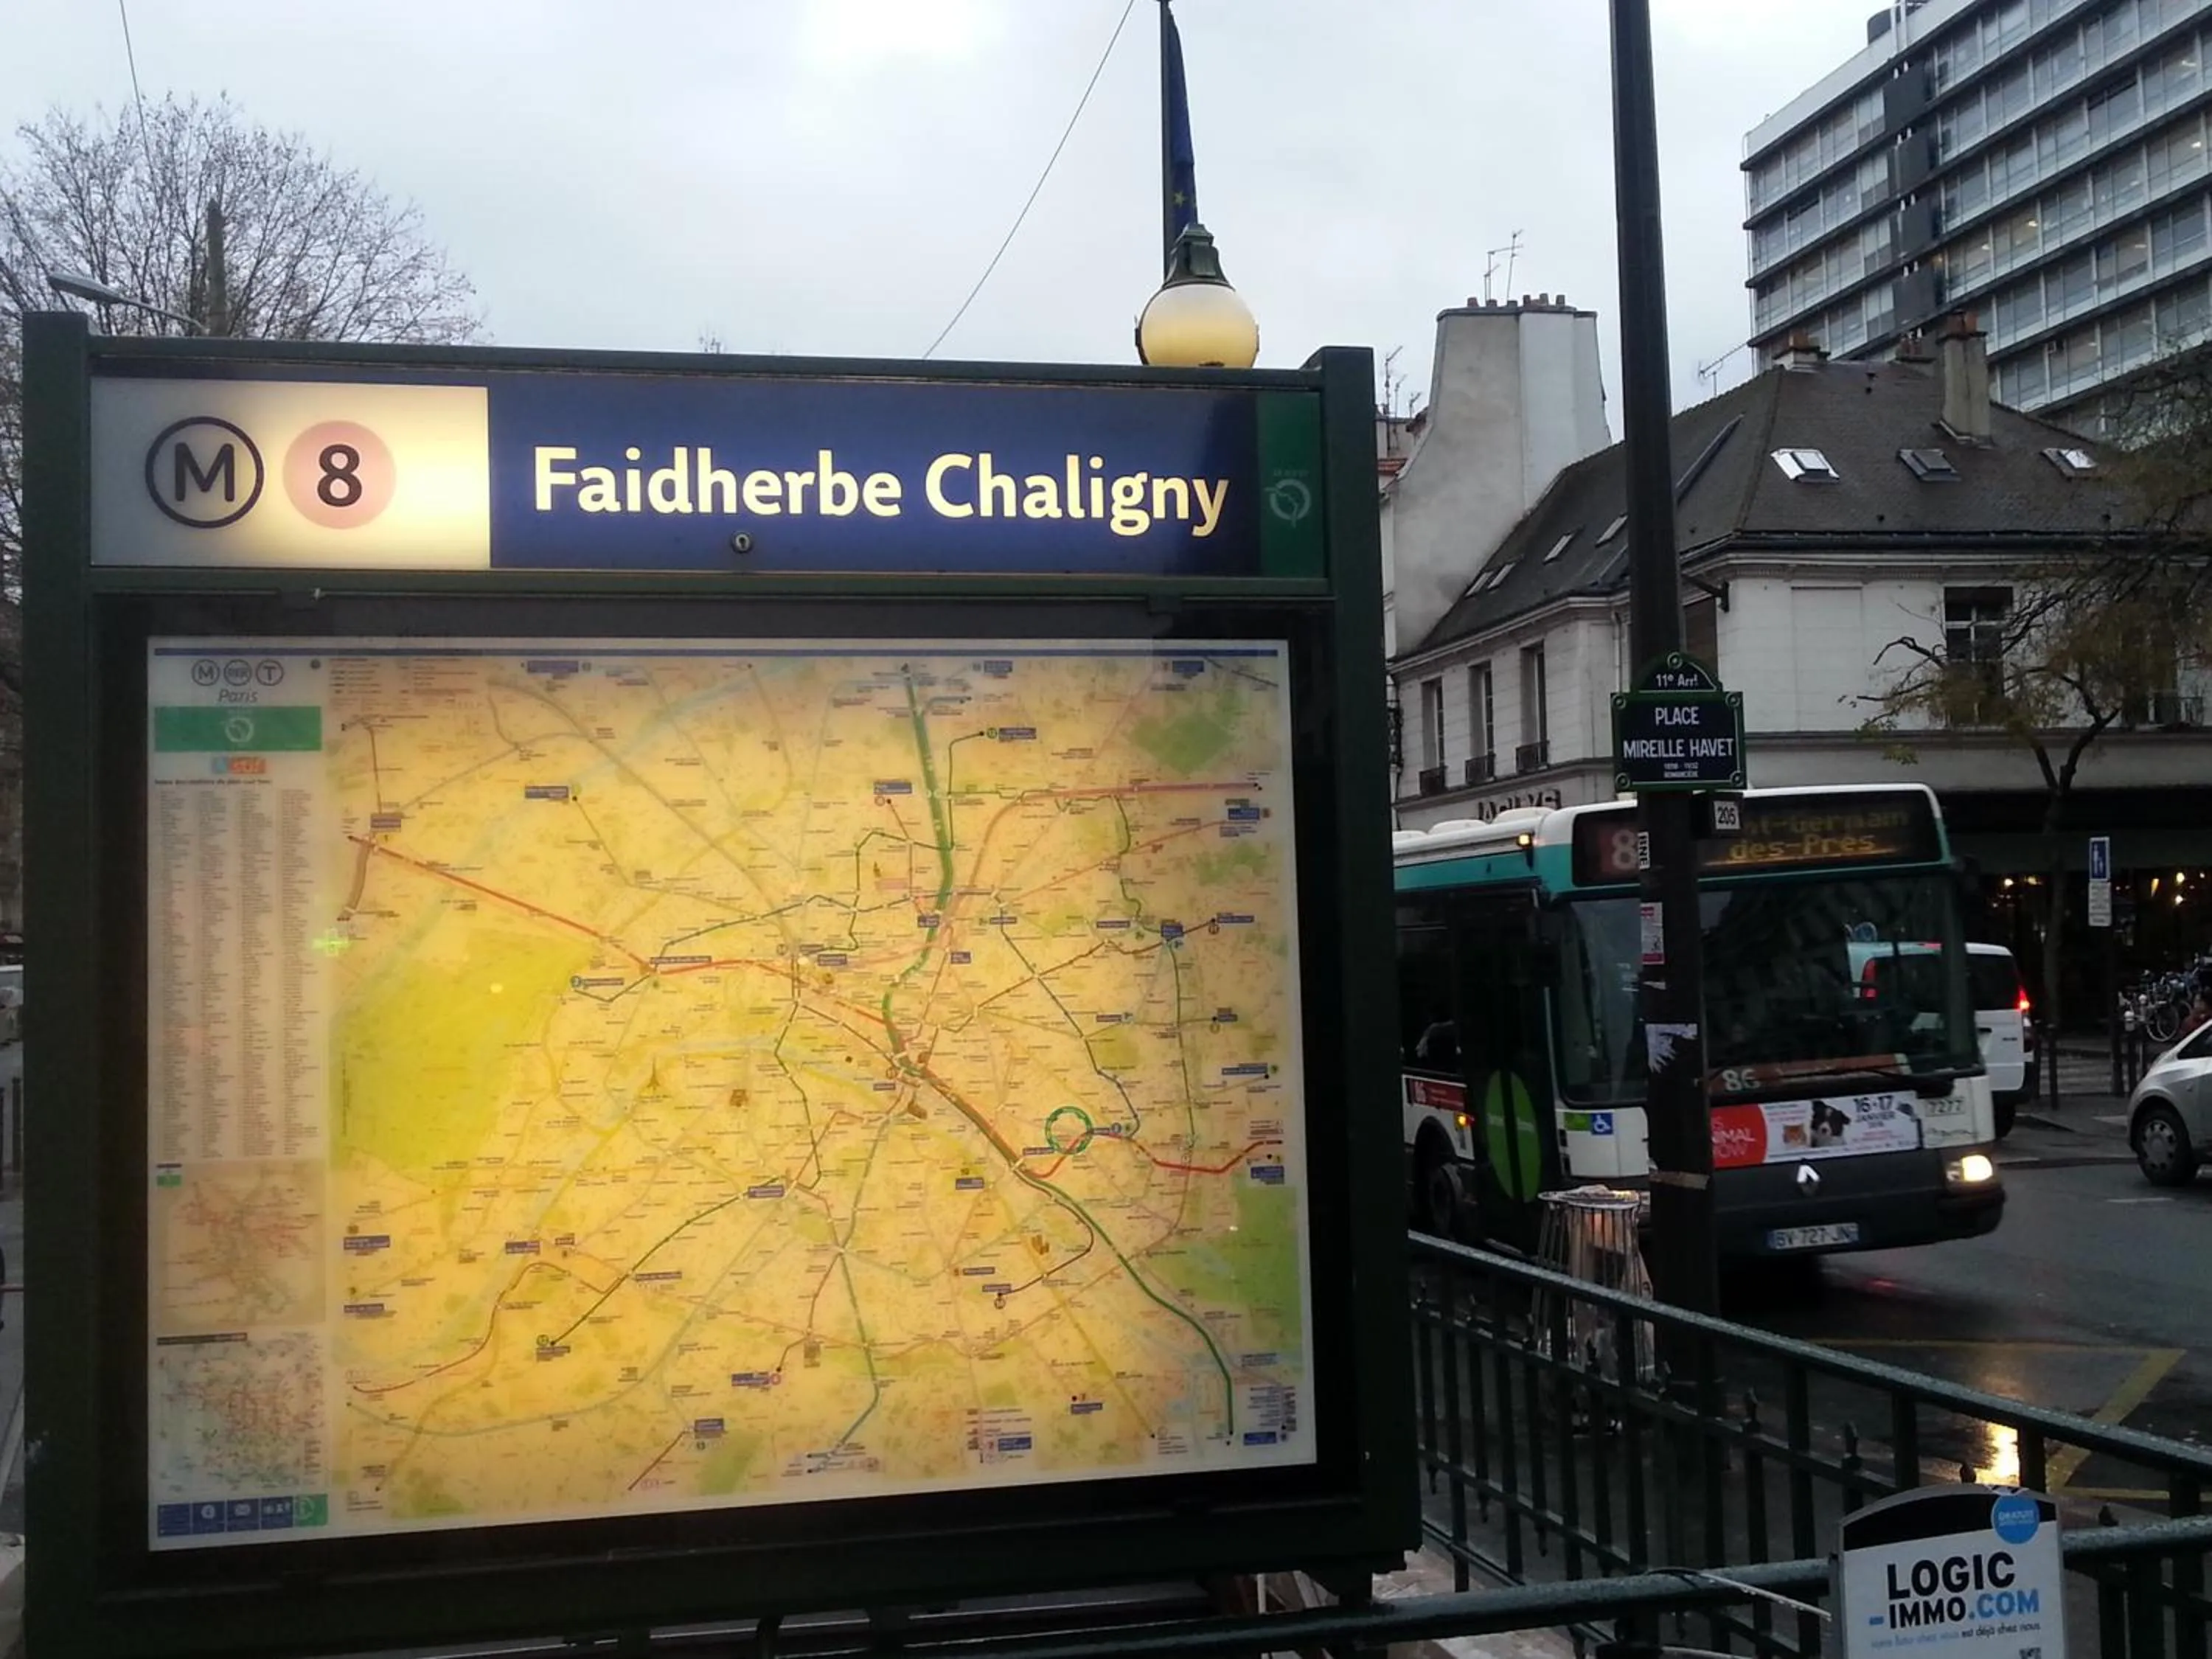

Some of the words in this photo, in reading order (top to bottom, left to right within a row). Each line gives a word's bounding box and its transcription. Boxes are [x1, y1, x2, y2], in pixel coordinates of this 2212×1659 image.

[175, 442, 234, 503] M
[317, 444, 362, 507] 8
[534, 446, 902, 517] Faidherbe
[925, 452, 1230, 537] Chaligny
[198, 665, 214, 680] M
[262, 666, 276, 681] T
[218, 688, 259, 702] Paris
[1655, 706, 1700, 726] PLACE
[1623, 739, 1686, 759] MIREILLE
[1689, 738, 1734, 758] HAVET
[1612, 829, 1637, 870] 8
[1722, 1069, 1760, 1091] 86
[1887, 1551, 2015, 1600] LOGIC
[1997, 1622, 2018, 1635] chez
